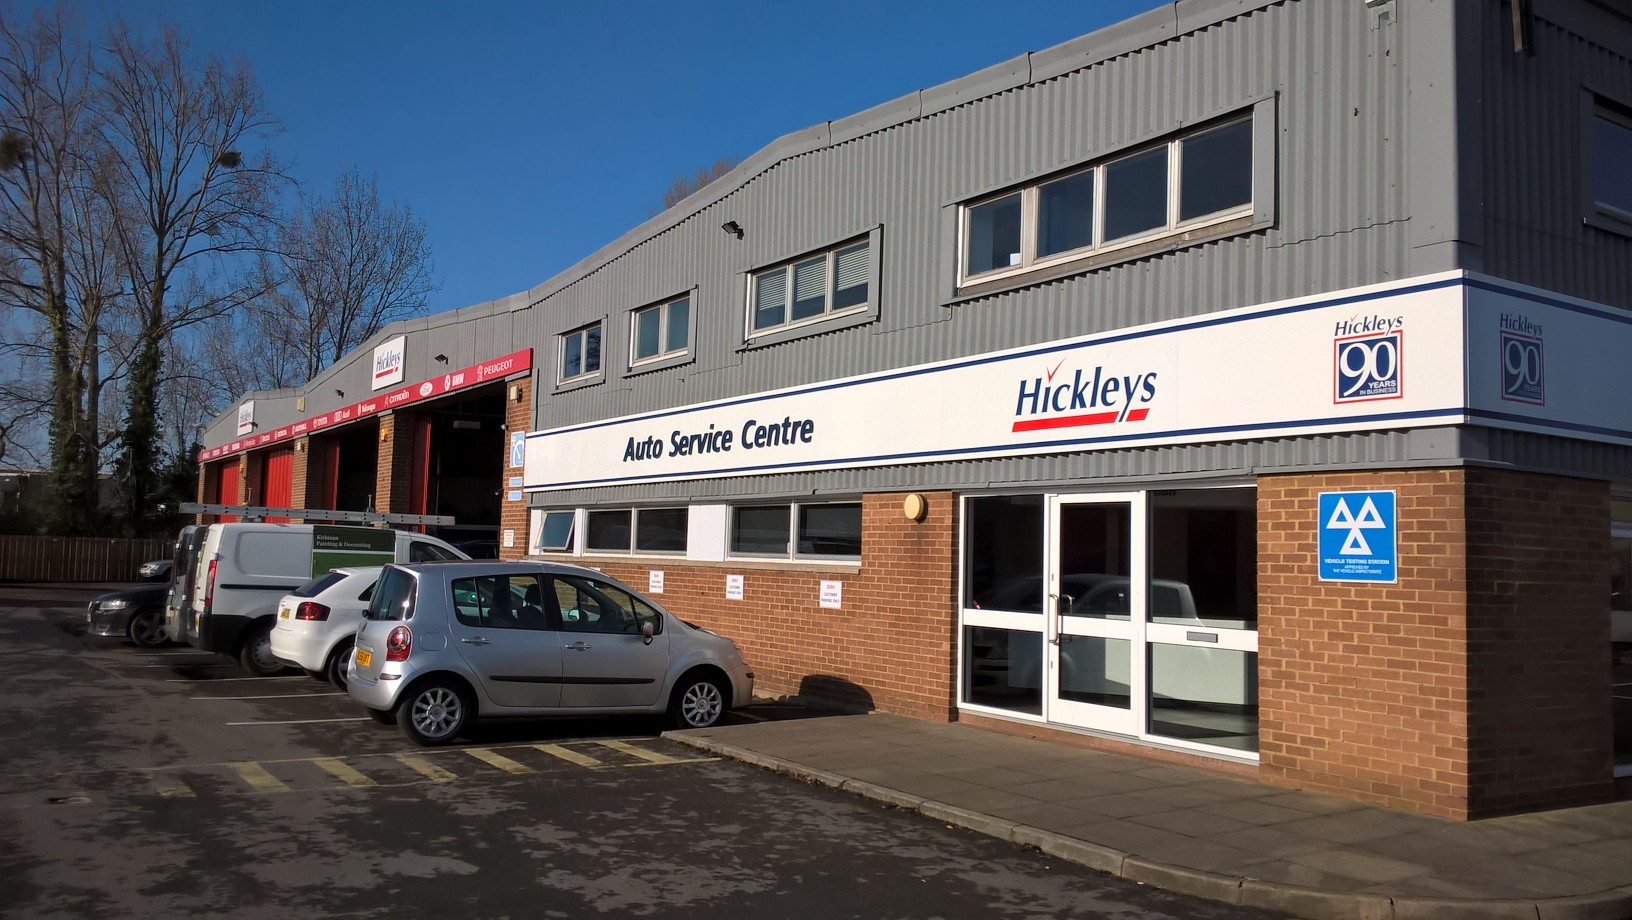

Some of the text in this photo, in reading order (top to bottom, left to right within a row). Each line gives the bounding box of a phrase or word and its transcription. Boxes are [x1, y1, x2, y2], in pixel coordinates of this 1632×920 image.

[1334, 314, 1403, 336] Hickleys
[1500, 312, 1543, 341] Hickleys
[376, 350, 401, 373] Hickleys
[483, 359, 513, 376] PEUGEOT
[1340, 341, 1396, 397] 90
[1504, 340, 1540, 393] 90
[452, 372, 465, 387] BMW
[1368, 380, 1396, 389] YEARS
[1015, 364, 1158, 423] Hickleys
[623, 416, 815, 462] Auto Service Centre
